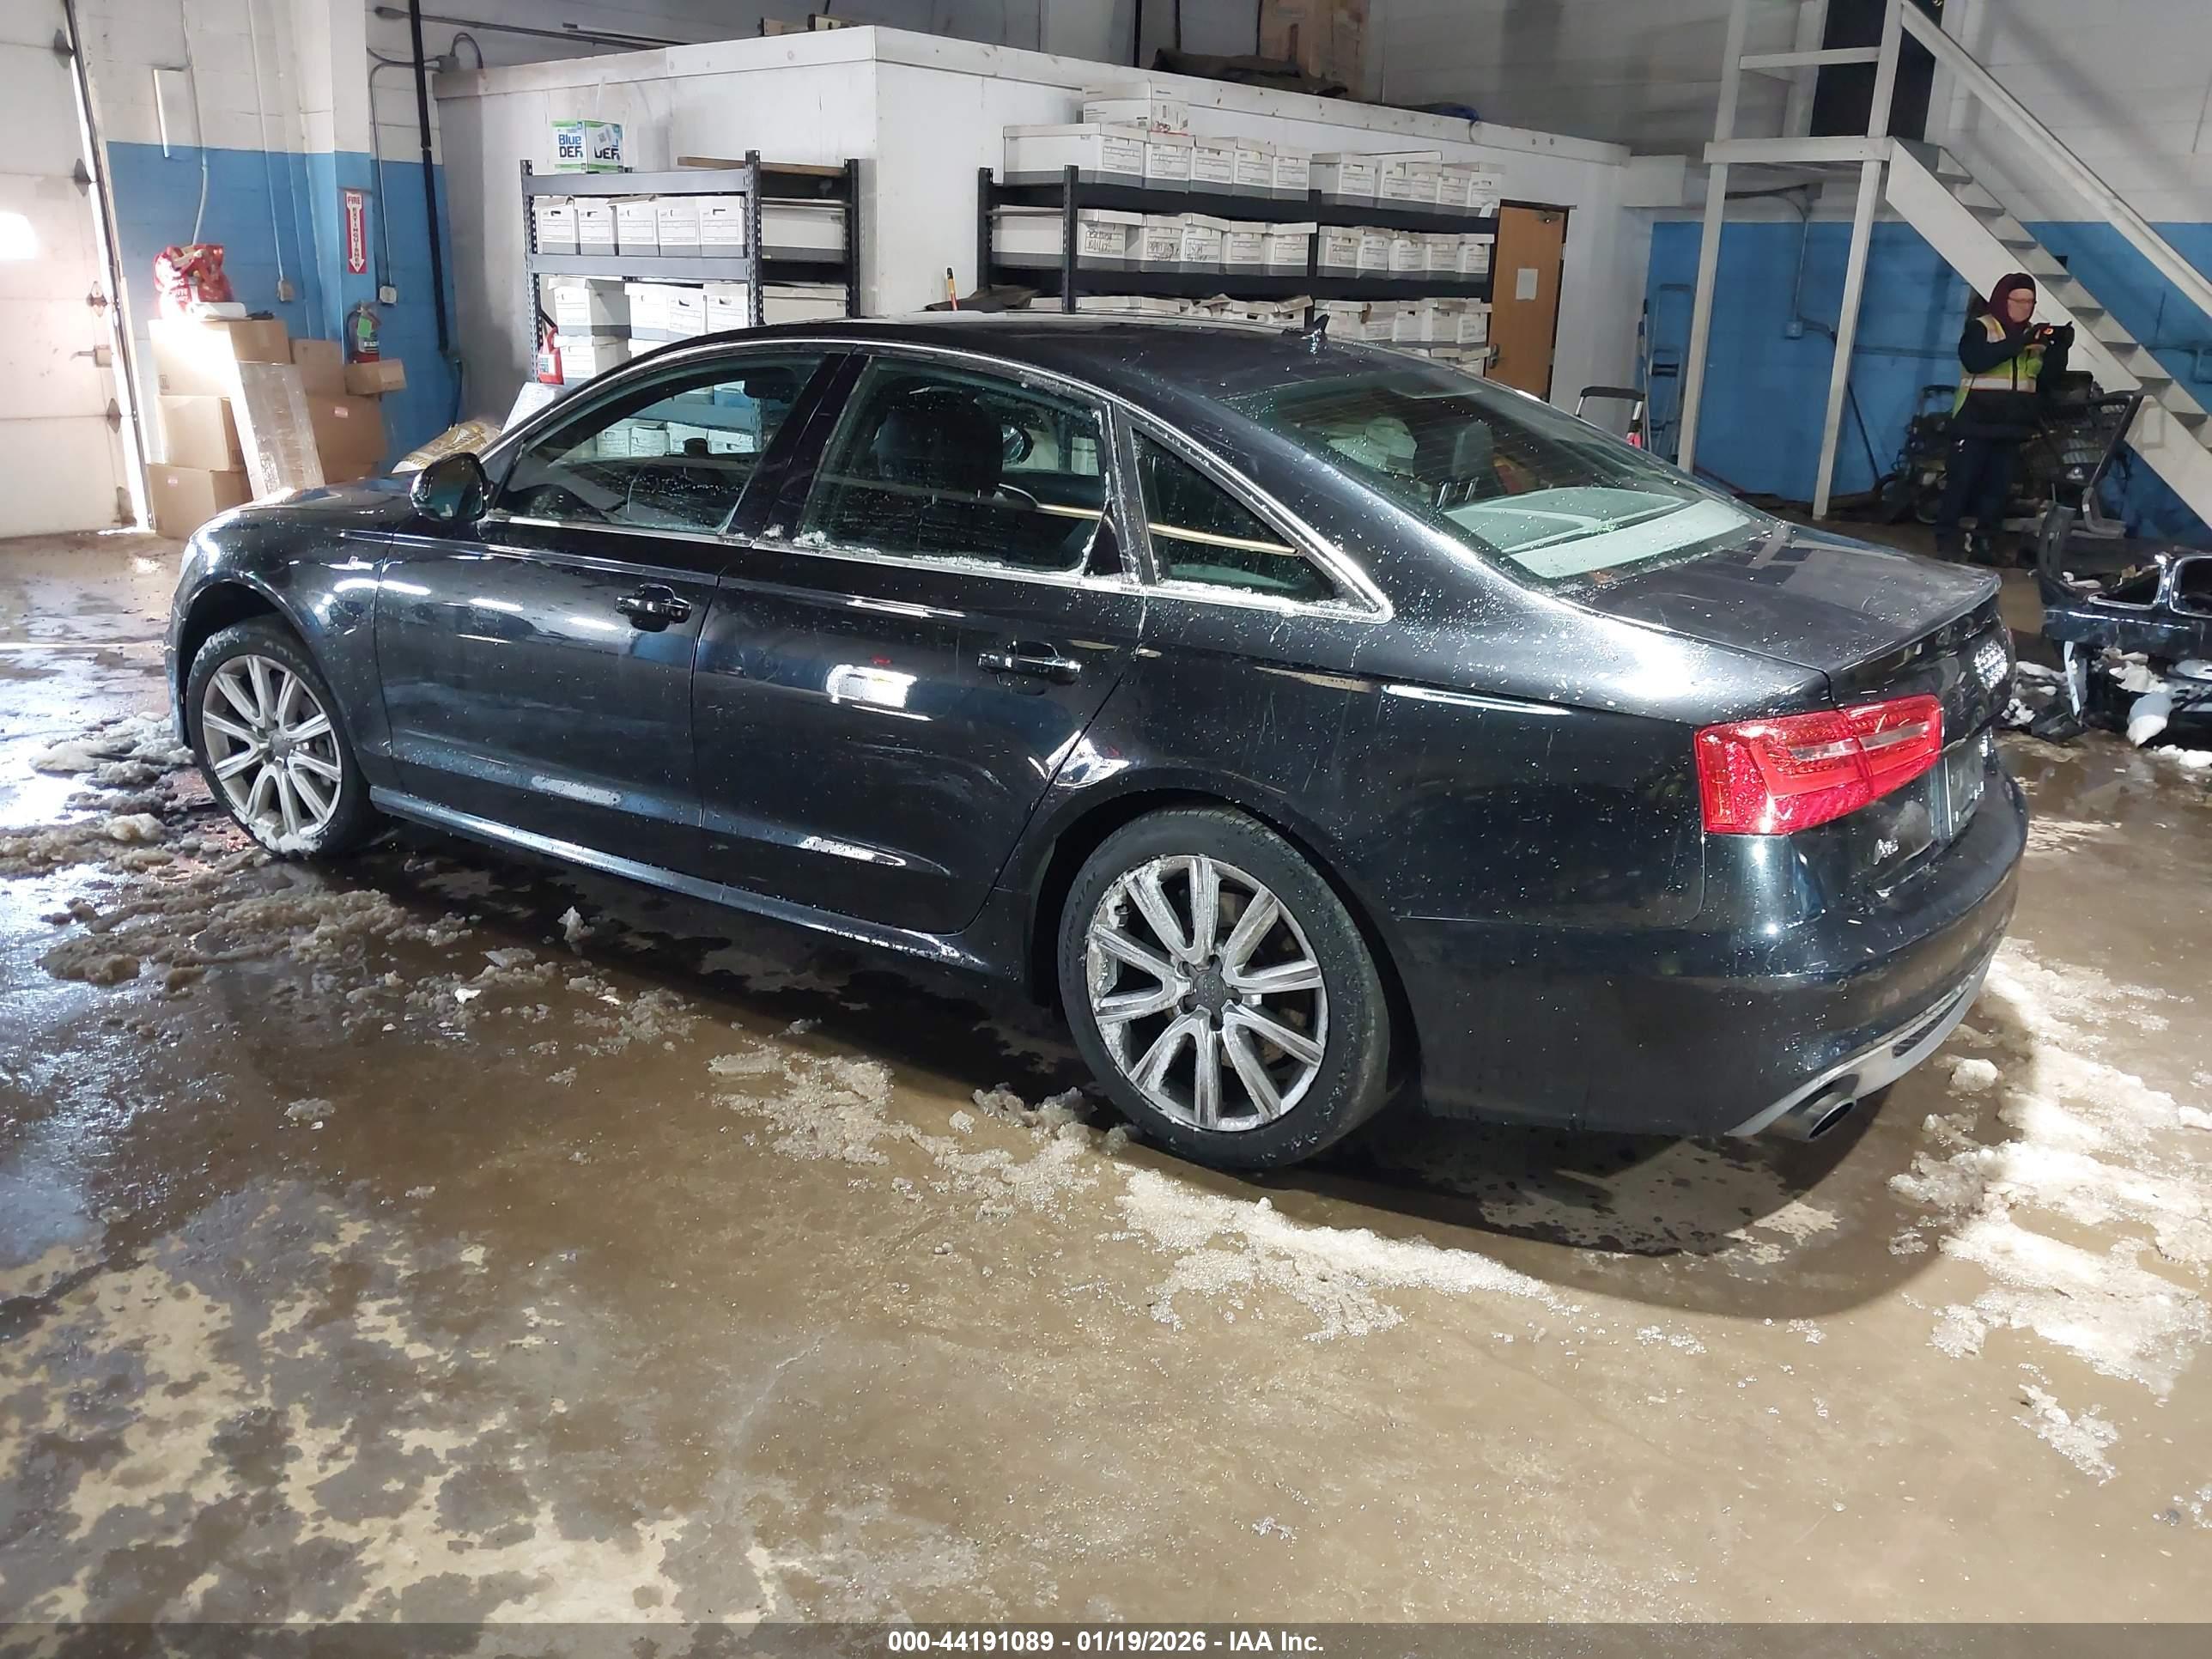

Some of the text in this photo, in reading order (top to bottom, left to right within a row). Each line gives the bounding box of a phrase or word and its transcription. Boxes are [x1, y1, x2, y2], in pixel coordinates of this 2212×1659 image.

[558, 134, 582, 145] Blue
[559, 146, 581, 158] DEF
[348, 196, 361, 205] FIRE
